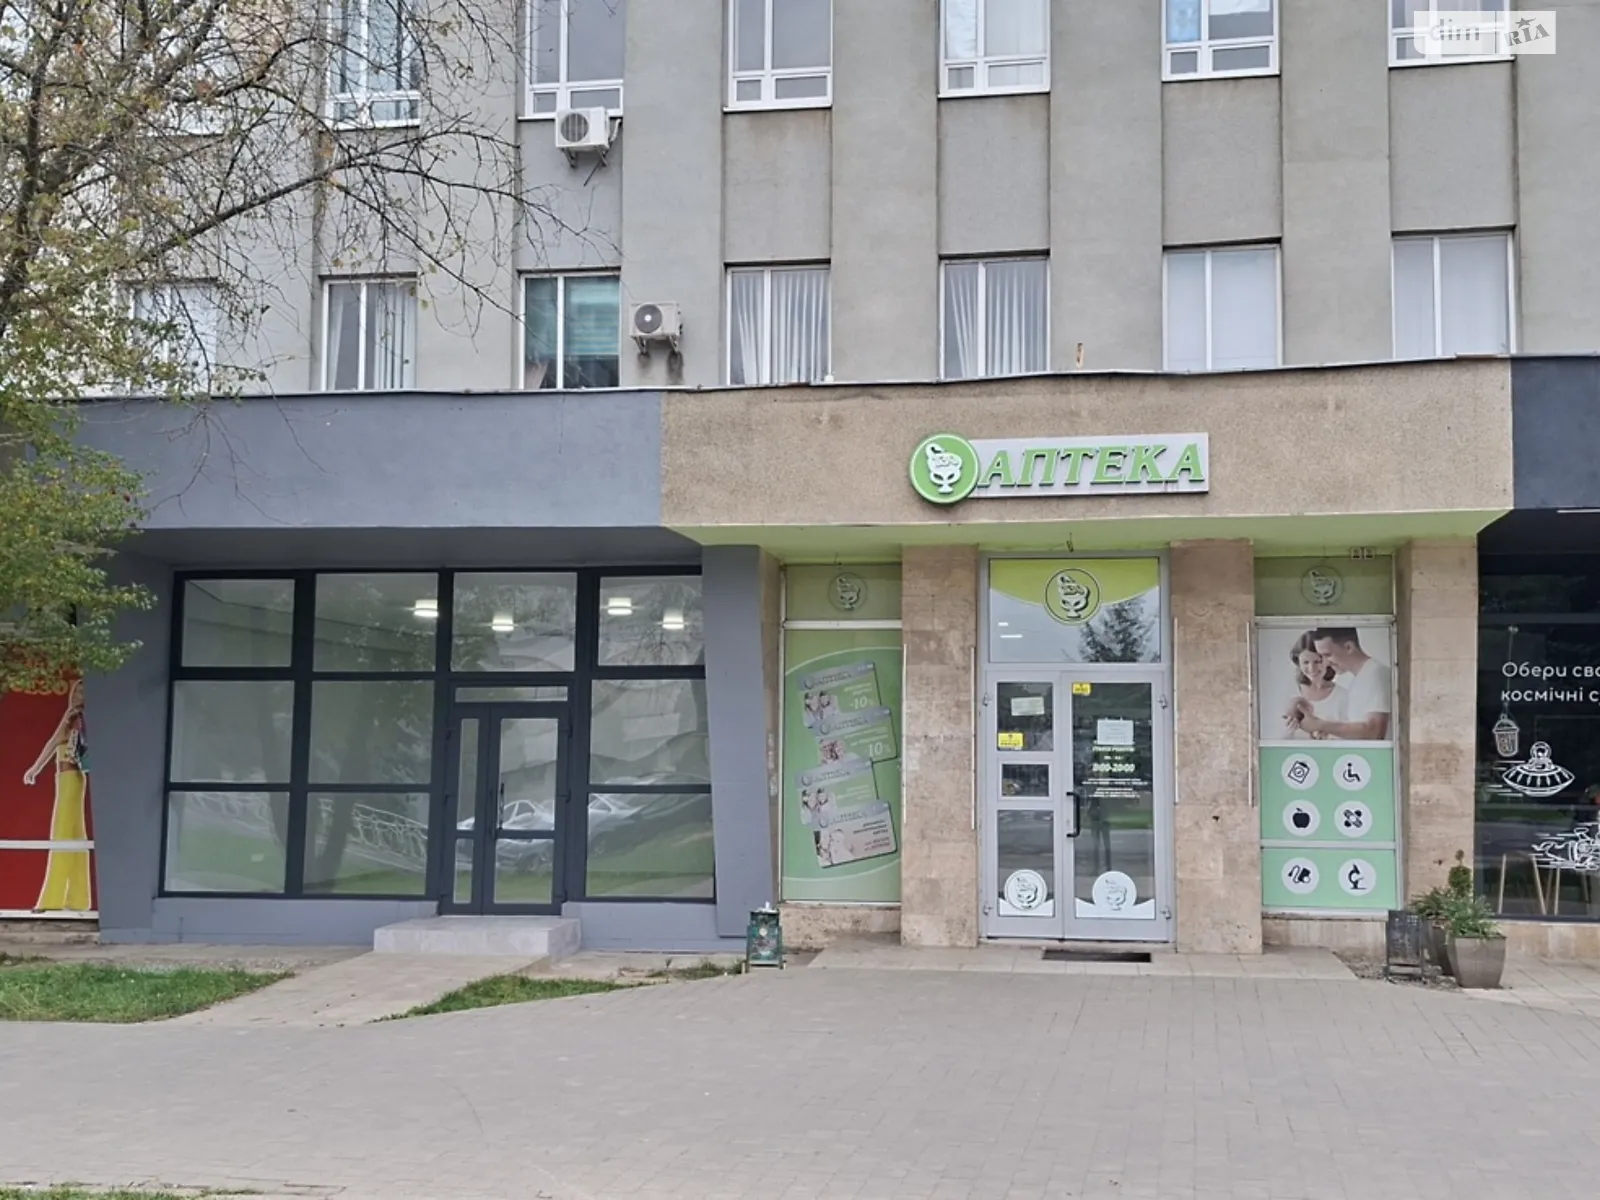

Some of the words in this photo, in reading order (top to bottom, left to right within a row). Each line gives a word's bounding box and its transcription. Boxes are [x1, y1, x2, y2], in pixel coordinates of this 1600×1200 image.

[977, 443, 1206, 487] АПТЕКА
[1502, 661, 1567, 680] Обери
[1501, 687, 1584, 702] космічні
